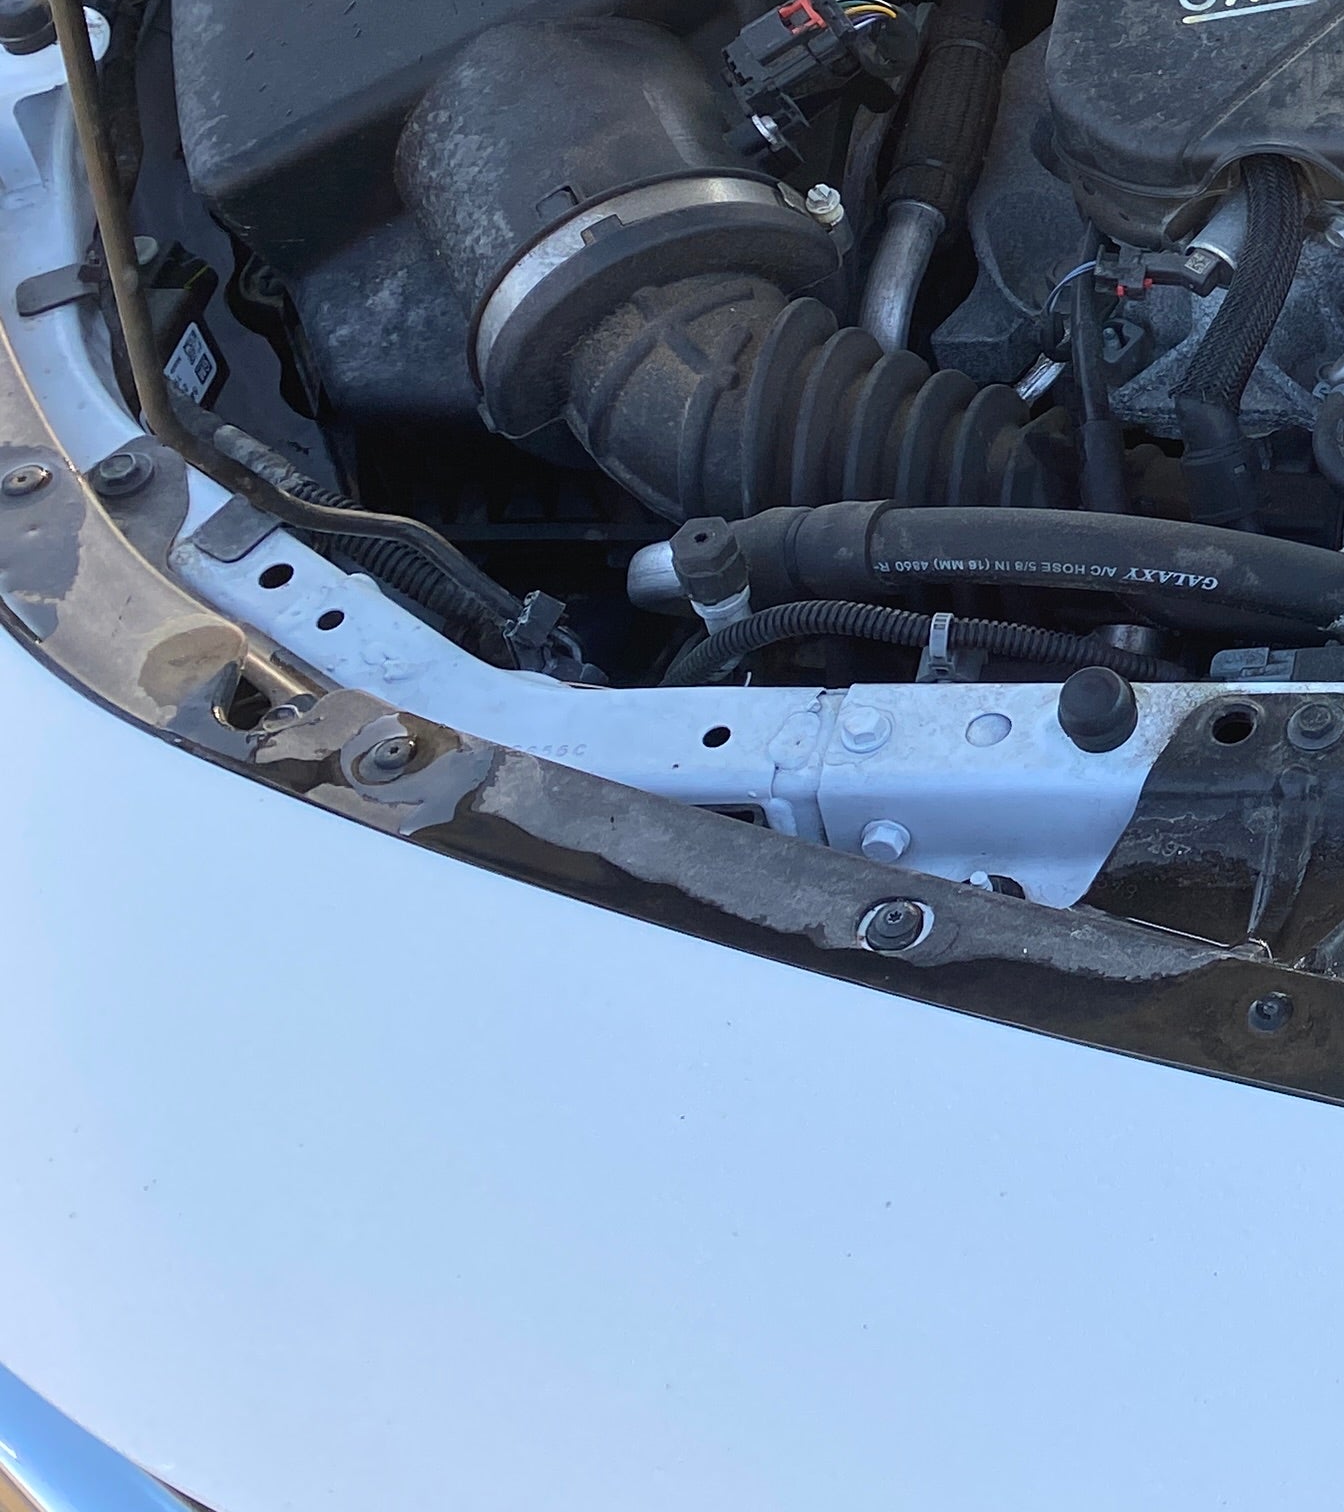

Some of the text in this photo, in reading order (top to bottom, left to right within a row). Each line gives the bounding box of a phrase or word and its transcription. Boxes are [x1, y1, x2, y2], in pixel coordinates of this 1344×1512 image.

[895, 560, 929, 572] 4860
[994, 560, 1010, 571] IN
[1014, 560, 1037, 572] 5/8
[1041, 561, 1086, 575] HOSE
[1090, 565, 1117, 578] A/C
[1122, 567, 1218, 590] GALAXY
